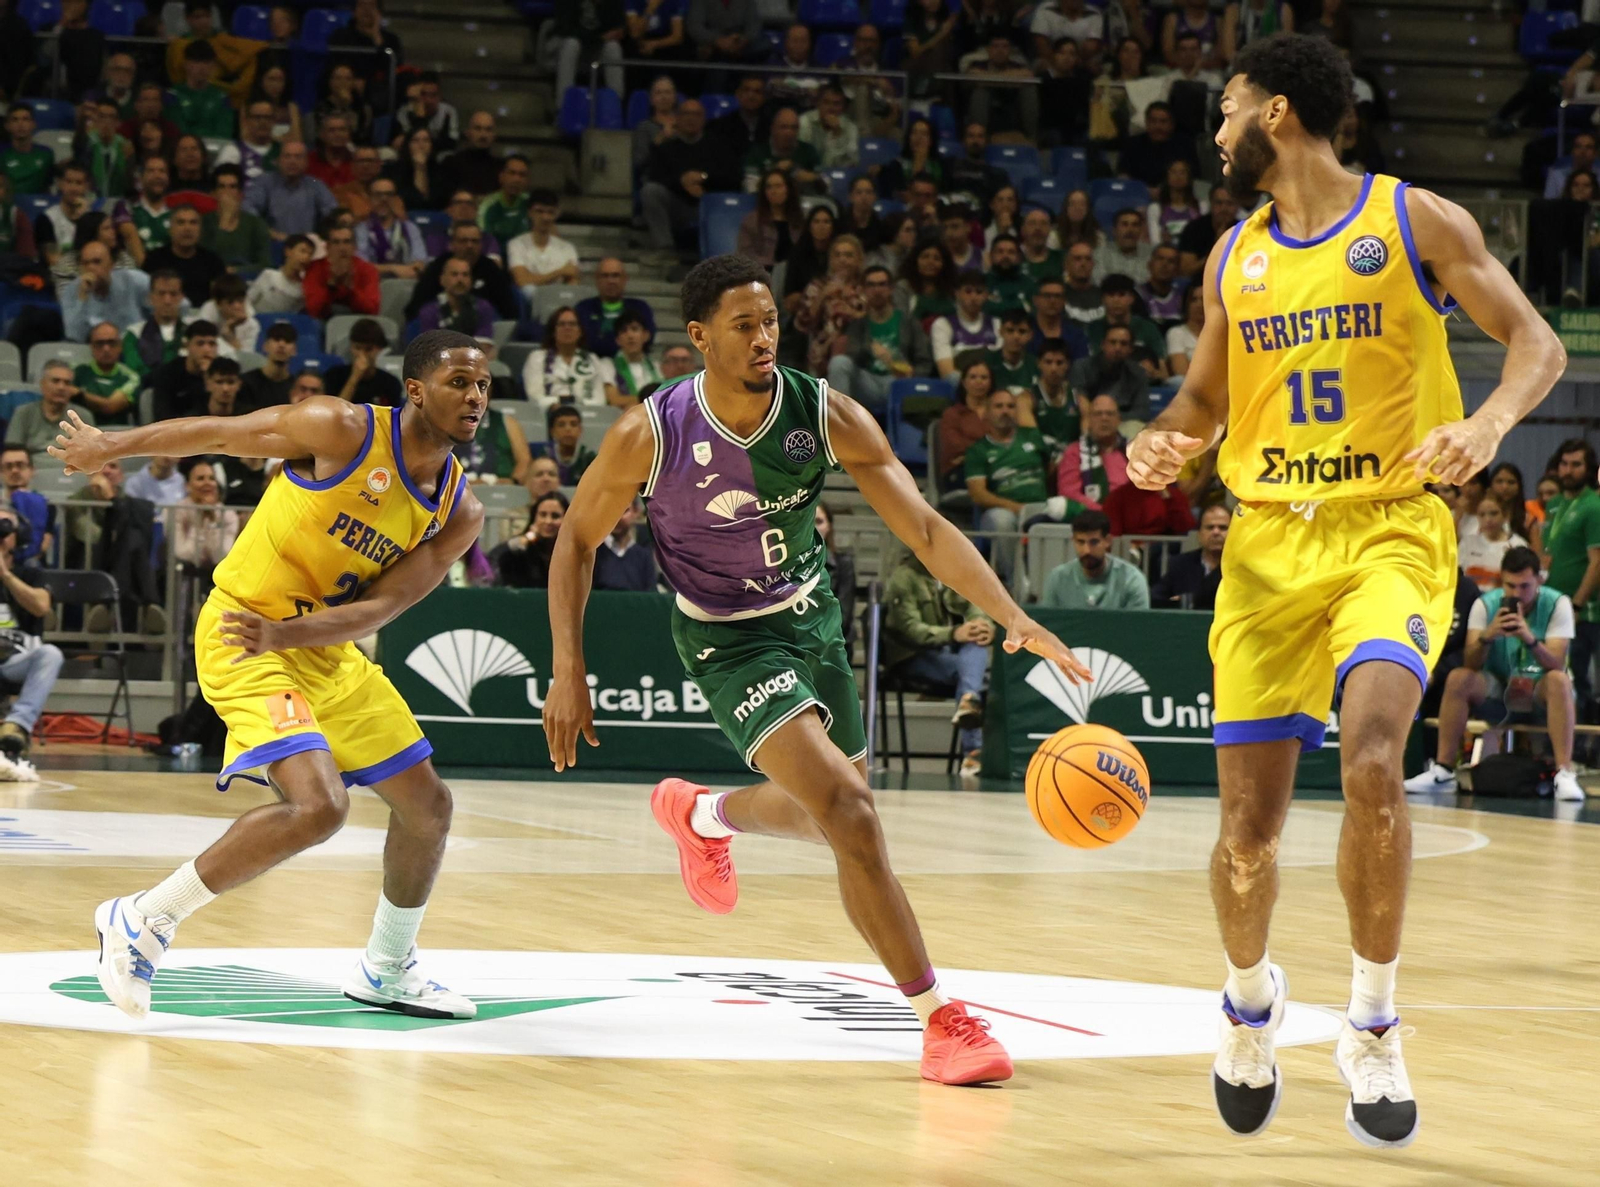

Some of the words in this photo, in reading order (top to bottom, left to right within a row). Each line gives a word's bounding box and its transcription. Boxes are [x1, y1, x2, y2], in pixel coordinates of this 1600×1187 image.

[1241, 283, 1266, 294] FILA
[1238, 302, 1383, 353] PERISTERI
[1284, 368, 1346, 425] 15
[358, 490, 379, 506] FILA
[760, 528, 788, 568] 6
[526, 674, 678, 720] Uicaja
[1142, 692, 1215, 728] Uni
[1096, 751, 1148, 809] Wilson
